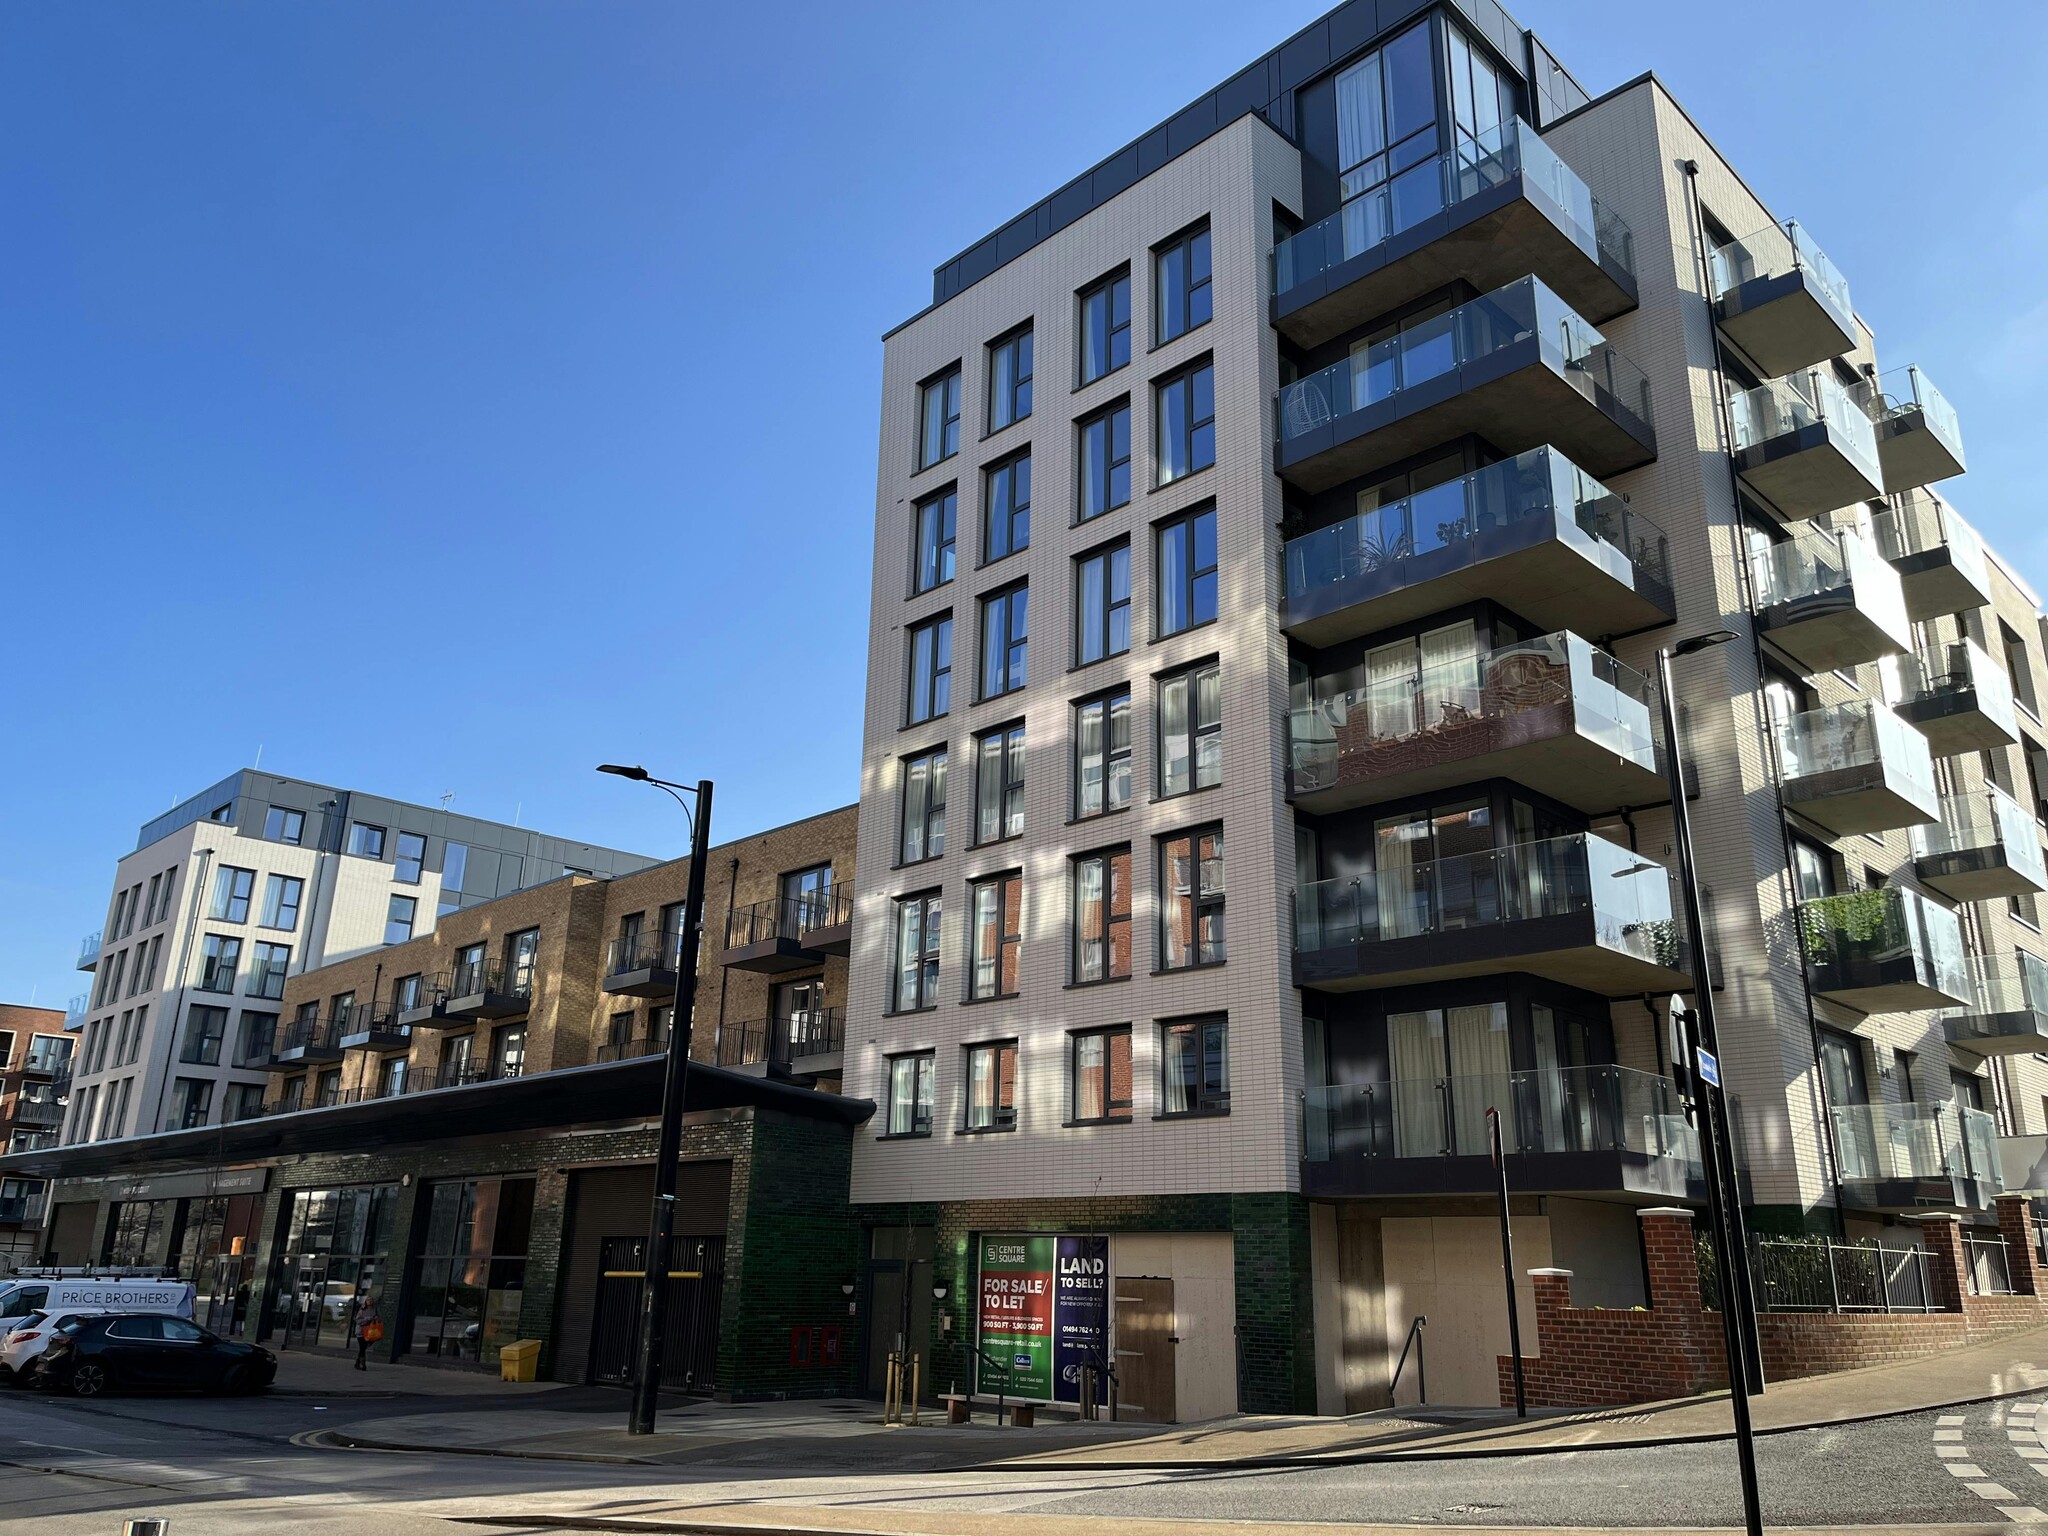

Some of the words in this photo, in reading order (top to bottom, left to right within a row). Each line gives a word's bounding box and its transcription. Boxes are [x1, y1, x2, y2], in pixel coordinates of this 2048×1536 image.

[998, 1245, 1025, 1254] CENTRE
[998, 1254, 1025, 1263] SQUARE
[1060, 1257, 1104, 1275] LAND
[984, 1278, 1009, 1293] FOR
[1010, 1278, 1049, 1296] SALE/
[1060, 1277, 1074, 1288] TO
[1075, 1277, 1104, 1289] SELL?
[105, 1292, 169, 1304] BROTHERS
[984, 1294, 1000, 1309] TO
[1002, 1295, 1025, 1310] LET
[983, 1320, 994, 1328] 900
[994, 1321, 1001, 1329] SQ
[1001, 1321, 1009, 1329] FT
[1027, 1323, 1035, 1331] SQ
[1035, 1323, 1044, 1331] FT
[1079, 1326, 1100, 1334] 76240
[982, 1338, 1042, 1348] centresquare-retail.co.uk
